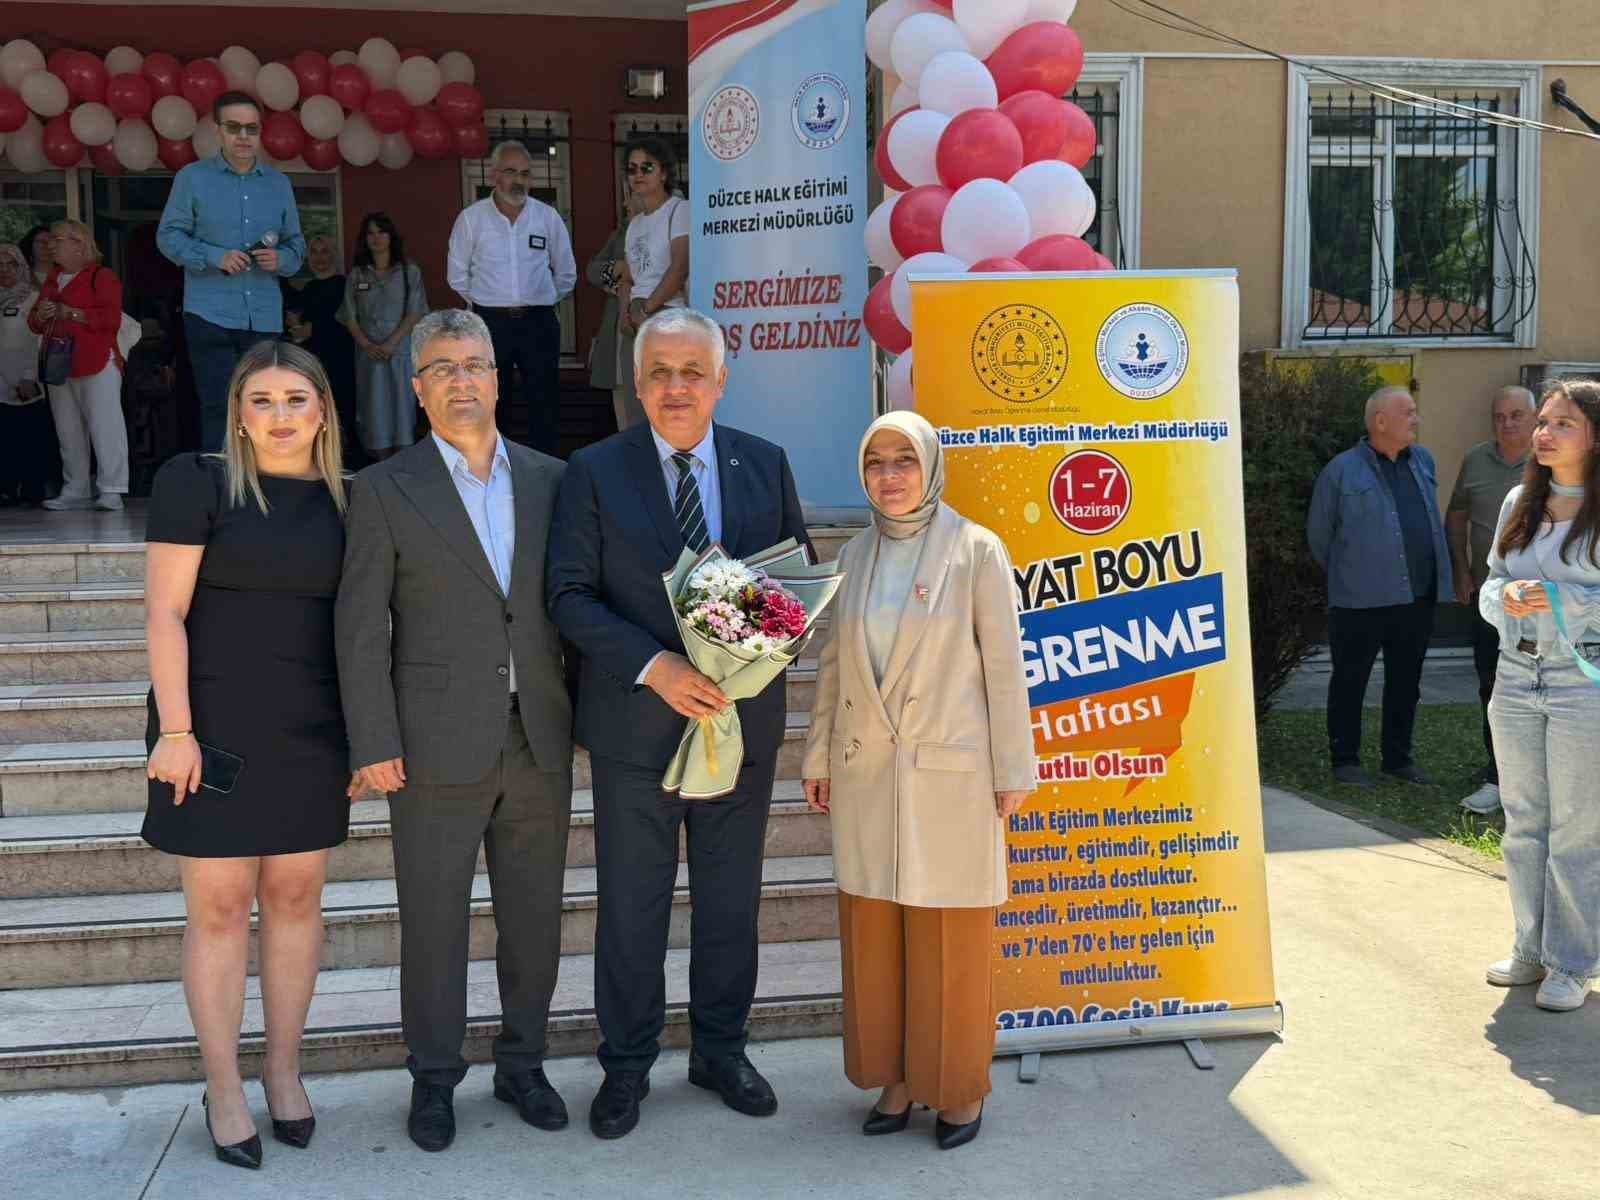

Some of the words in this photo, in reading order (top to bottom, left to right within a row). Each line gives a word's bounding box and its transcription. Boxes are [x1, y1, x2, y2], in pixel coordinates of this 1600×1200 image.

[708, 187, 752, 209] DÜZCE
[754, 186, 790, 206] HALK
[794, 176, 849, 203] EĞİTİMİ
[703, 213, 761, 237] MERKEZİ
[763, 204, 854, 232] MÜDÜRLÜĞÜ
[713, 269, 842, 310] SERGİMİZE
[750, 312, 862, 353] GELDİNİZ
[936, 429, 976, 446] üzce
[979, 427, 1015, 444] Halk
[1019, 425, 1074, 446] Eğitimi
[1079, 423, 1140, 442] Merkezi
[1143, 421, 1229, 442] Müdürlüğü
[1063, 502, 1122, 518] Haziran
[1093, 530, 1202, 594] BOYU
[1018, 604, 1222, 688] ĞRENME
[1034, 754, 1088, 780] utlu
[1094, 752, 1164, 777] Olsun
[1009, 811, 1045, 832] Halk
[1048, 808, 1099, 834] Eğitim
[1103, 802, 1193, 827] Merkezimiz
[1008, 843, 1073, 864] kurstur,
[1077, 837, 1155, 864] eğitimdir,
[1159, 831, 1240, 860] gelişimdir
[1011, 877, 1045, 895] ama
[1048, 869, 1106, 893] birazda
[1110, 866, 1198, 888] dostluktur.
[1066, 899, 1147, 922] üretimdir,
[1151, 896, 1238, 920] kazançtır...
[1002, 943, 1021, 958] ve
[1024, 935, 1069, 957] 7'den
[1072, 932, 1106, 953] 70'e
[1110, 930, 1139, 950] her
[1140, 928, 1184, 954] gelen
[1187, 924, 1216, 952] için
[1059, 961, 1162, 987] mutluluktur.
